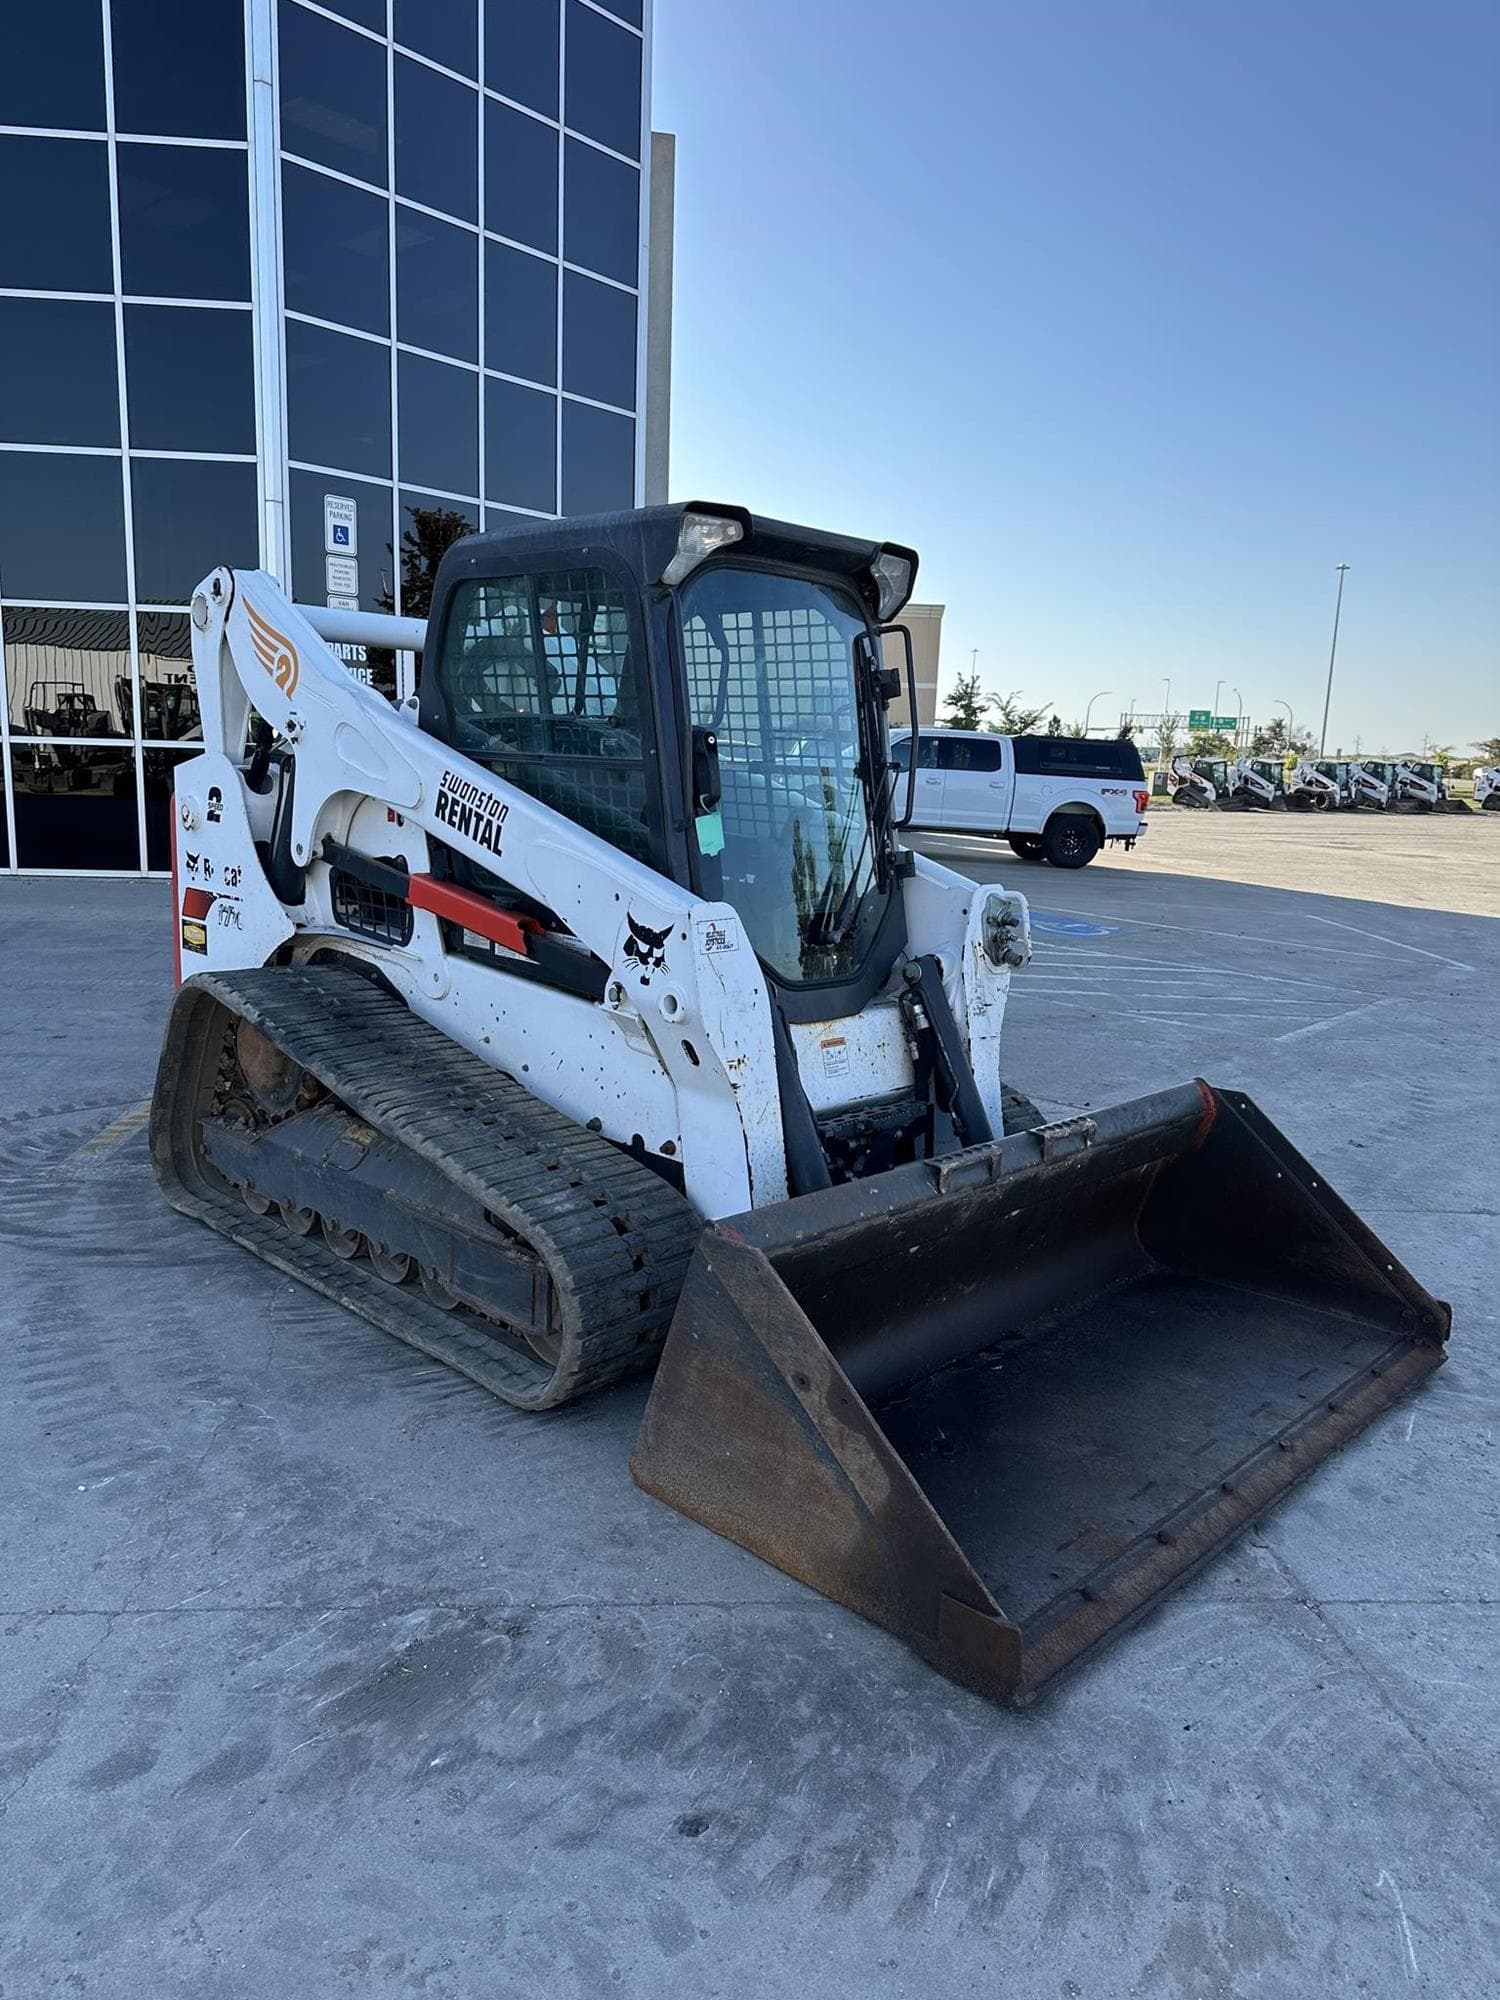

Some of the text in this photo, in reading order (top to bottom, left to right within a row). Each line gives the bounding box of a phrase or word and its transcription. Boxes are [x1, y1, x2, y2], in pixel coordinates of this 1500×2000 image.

[328, 500, 354, 513] RESERVED
[329, 510, 353, 522] PARKING
[325, 641, 367, 661] PARTS
[208, 801, 224, 812] SPEED
[434, 789, 503, 858] RENTAL
